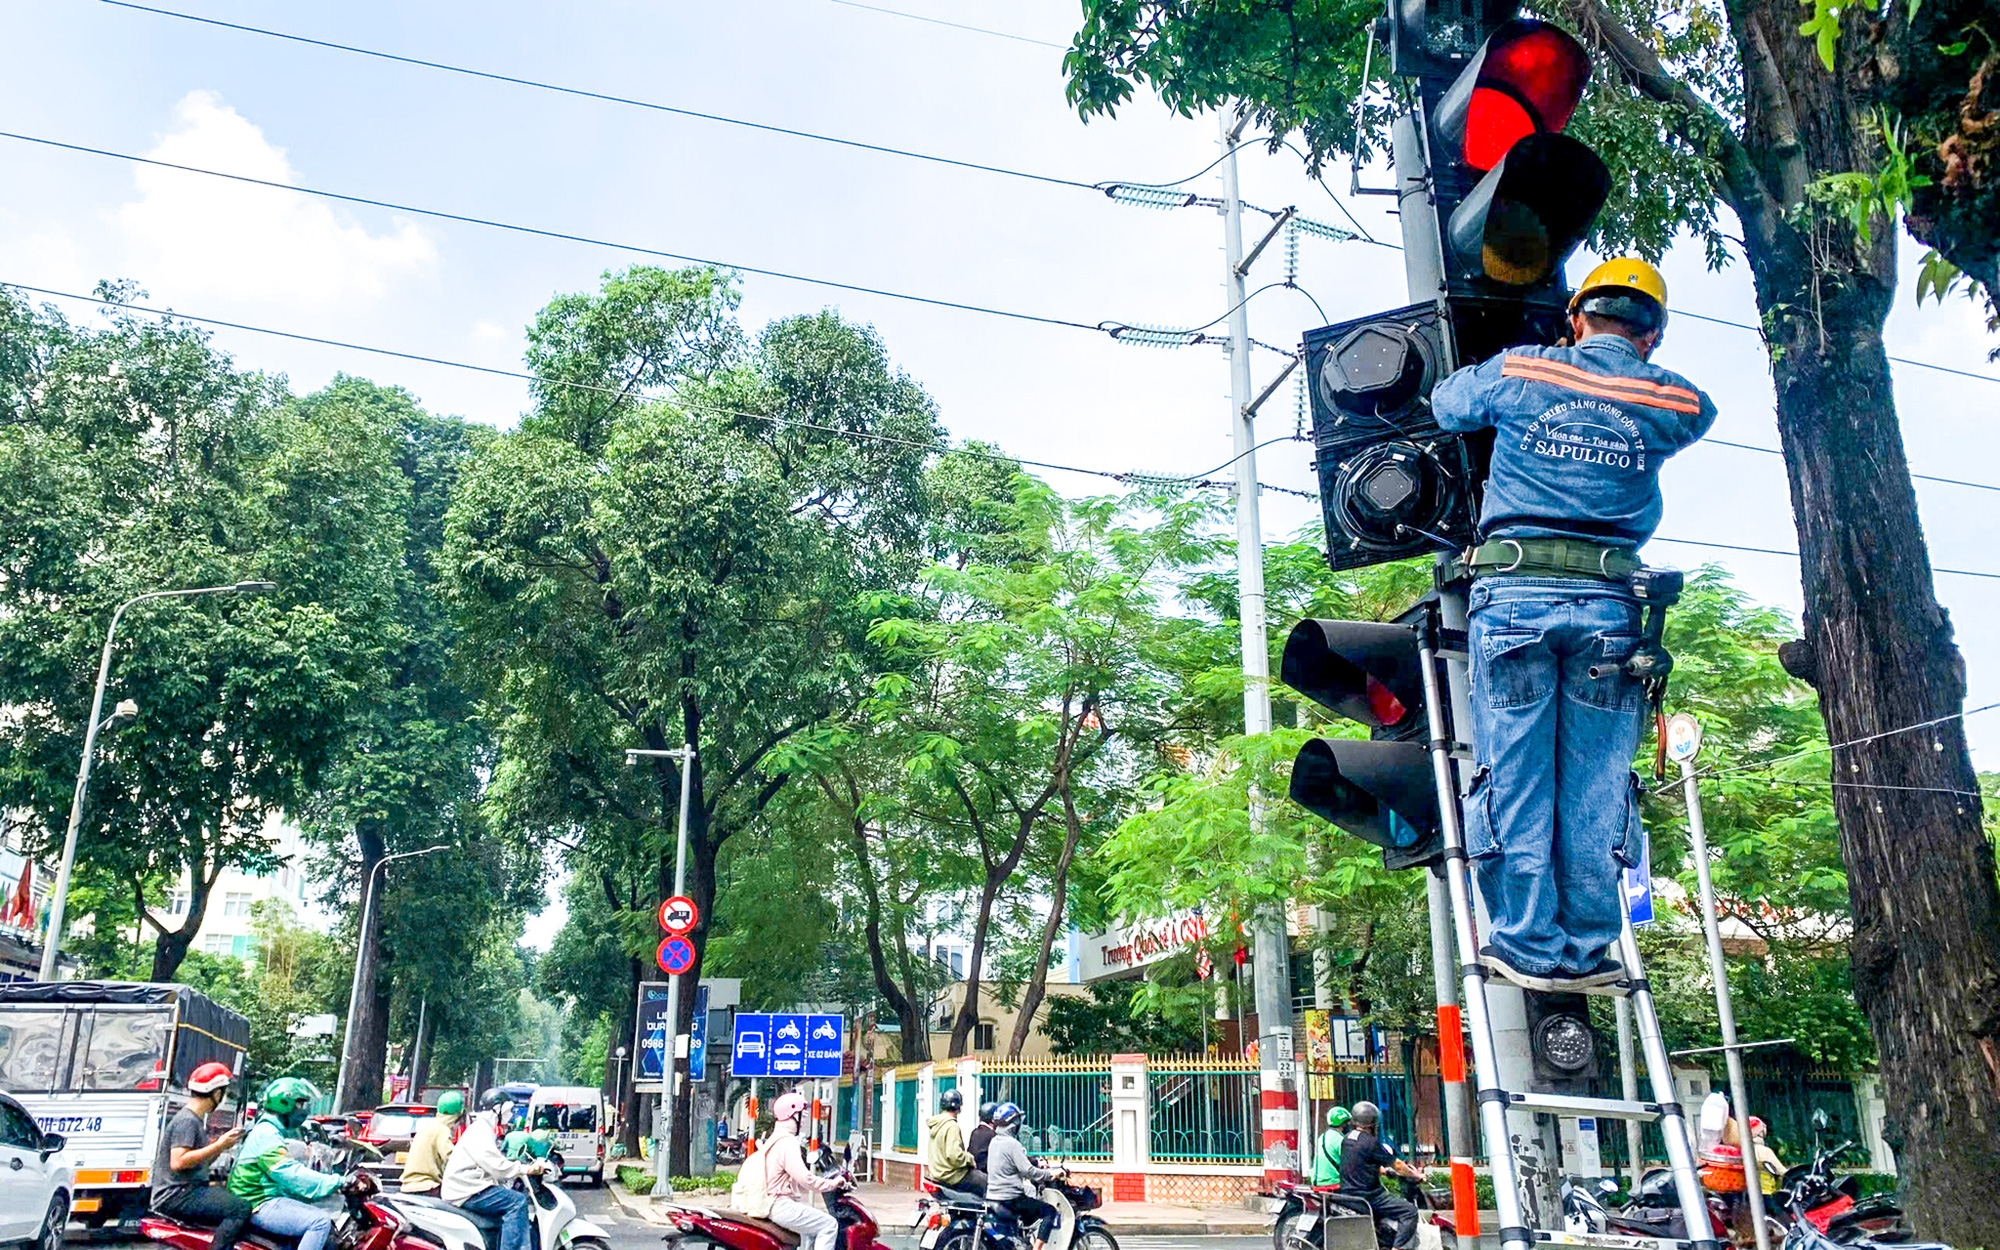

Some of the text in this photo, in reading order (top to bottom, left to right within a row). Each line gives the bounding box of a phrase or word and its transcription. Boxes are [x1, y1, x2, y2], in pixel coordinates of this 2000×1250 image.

[1570, 399, 1596, 411] SÁNG
[1598, 402, 1623, 419] CÔNG
[1621, 416, 1640, 438] CỘNG
[1534, 440, 1631, 469] SAPULICO
[641, 1038, 664, 1049] 0986
[807, 1050, 816, 1059] XE
[824, 1048, 842, 1059] BÁNH
[1280, 1062, 1291, 1071] 22
[34, 1116, 103, 1133] 0H-672.48
